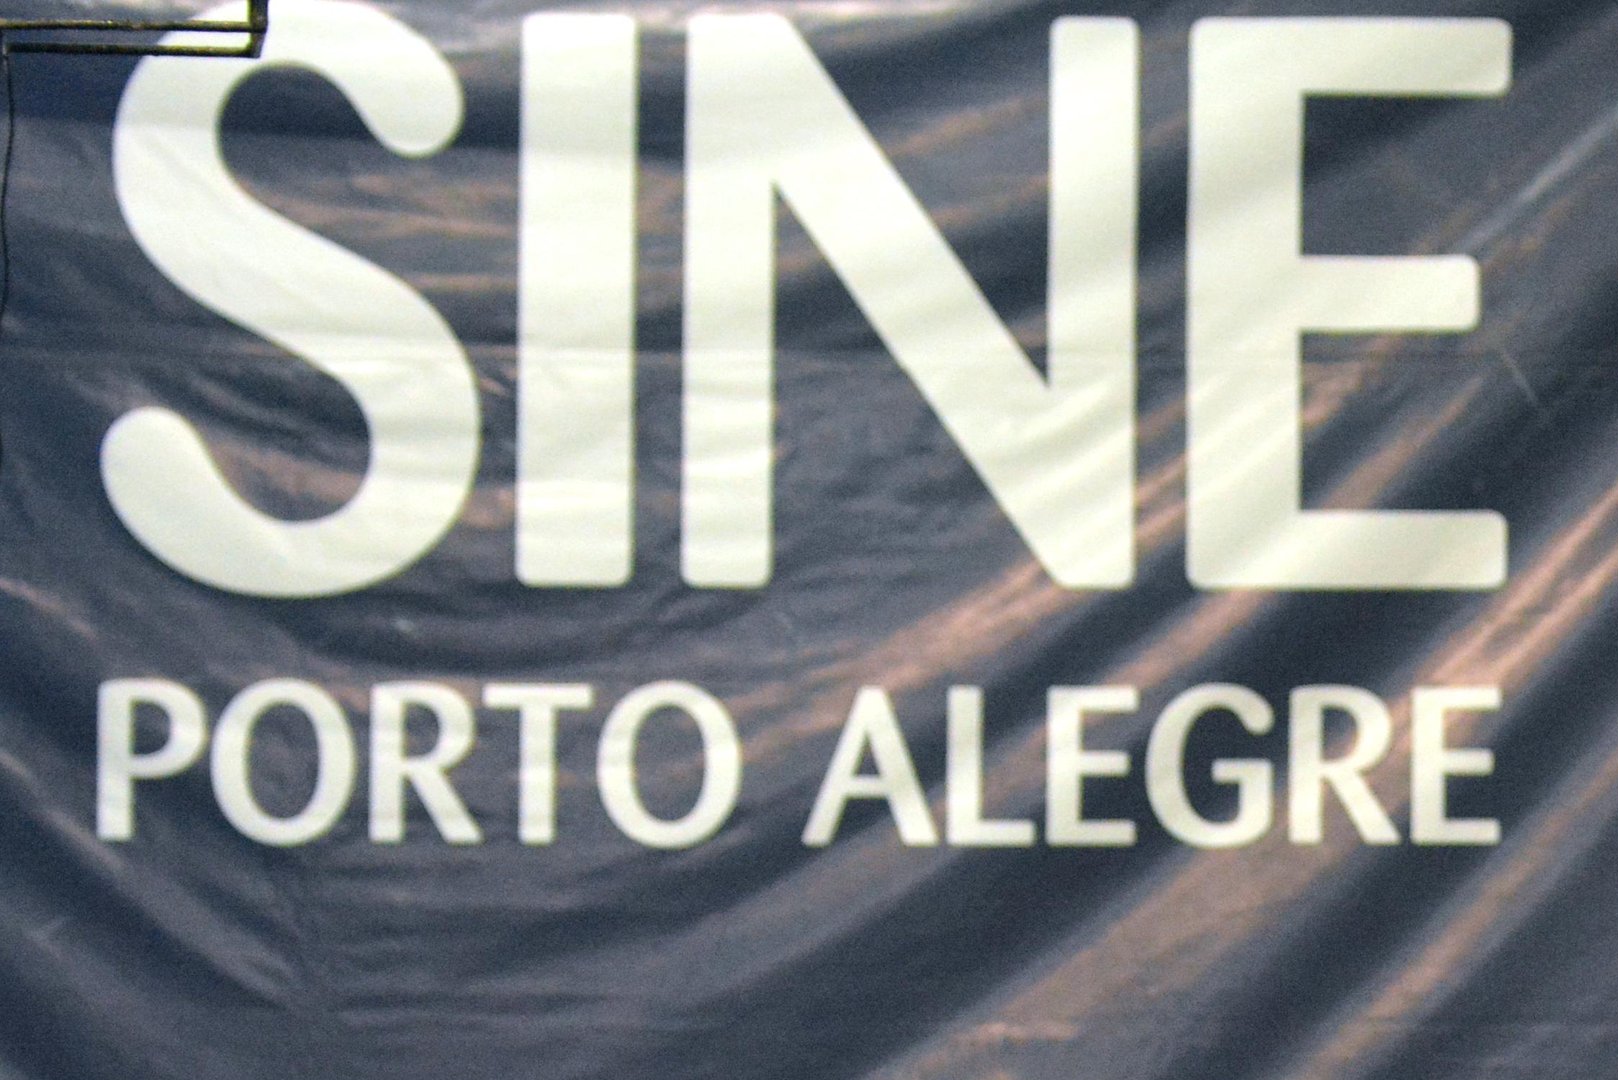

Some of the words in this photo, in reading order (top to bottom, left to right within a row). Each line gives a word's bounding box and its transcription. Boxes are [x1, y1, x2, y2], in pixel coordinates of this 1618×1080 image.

[100, 0, 1513, 598] SINE
[95, 678, 744, 848] PORTO
[801, 682, 1502, 848] ALEGRE
